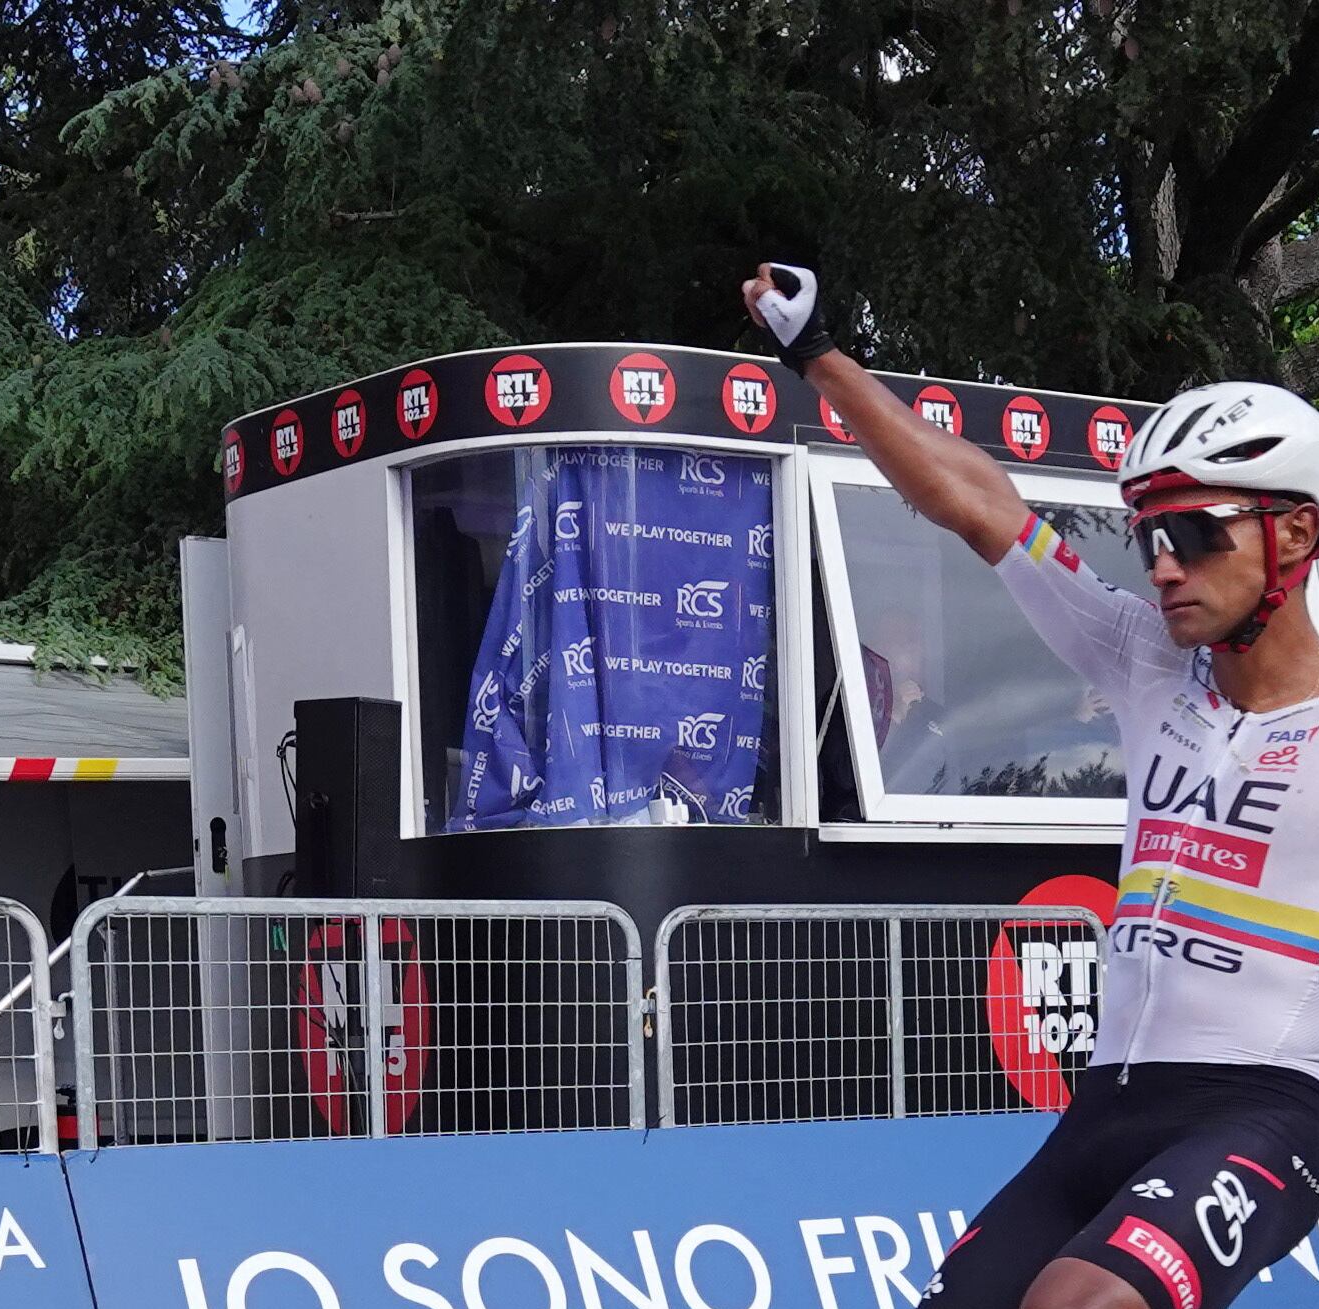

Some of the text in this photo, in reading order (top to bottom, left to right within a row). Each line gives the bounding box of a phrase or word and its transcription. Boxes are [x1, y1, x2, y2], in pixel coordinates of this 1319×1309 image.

[496, 372, 538, 395] RTL
[623, 371, 664, 393] RTL
[732, 380, 767, 402] RTL
[402, 385, 429, 411] RTL
[497, 393, 539, 408] 102.5
[624, 392, 665, 406] 102.5
[733, 400, 767, 416] 102.5
[337, 405, 360, 429] RTL
[403, 405, 430, 422] 102.5
[922, 401, 953, 424] RTL
[1011, 411, 1041, 432] RTL
[1197, 395, 1255, 445] MET
[275, 424, 298, 448] RTL
[338, 423, 361, 441] 102.5
[1012, 430, 1041, 445] 102.5
[1096, 421, 1125, 443] RTL
[277, 443, 299, 460] 102.5
[1097, 440, 1125, 453] 102.5
[681, 452, 726, 485] RCS
[605, 521, 733, 547] WE PLAY TOGETHER
[747, 528, 773, 559] RC
[676, 587, 724, 617] RCS
[562, 646, 595, 677] RC
[604, 656, 732, 680] WE PLAY TOGETHER
[741, 661, 766, 690] RC
[677, 720, 718, 749] RCS
[1142, 754, 1291, 835] UAE
[1139, 830, 1249, 871] Emirates
[1021, 941, 1098, 1007] RT
[1023, 1011, 1095, 1055] 102
